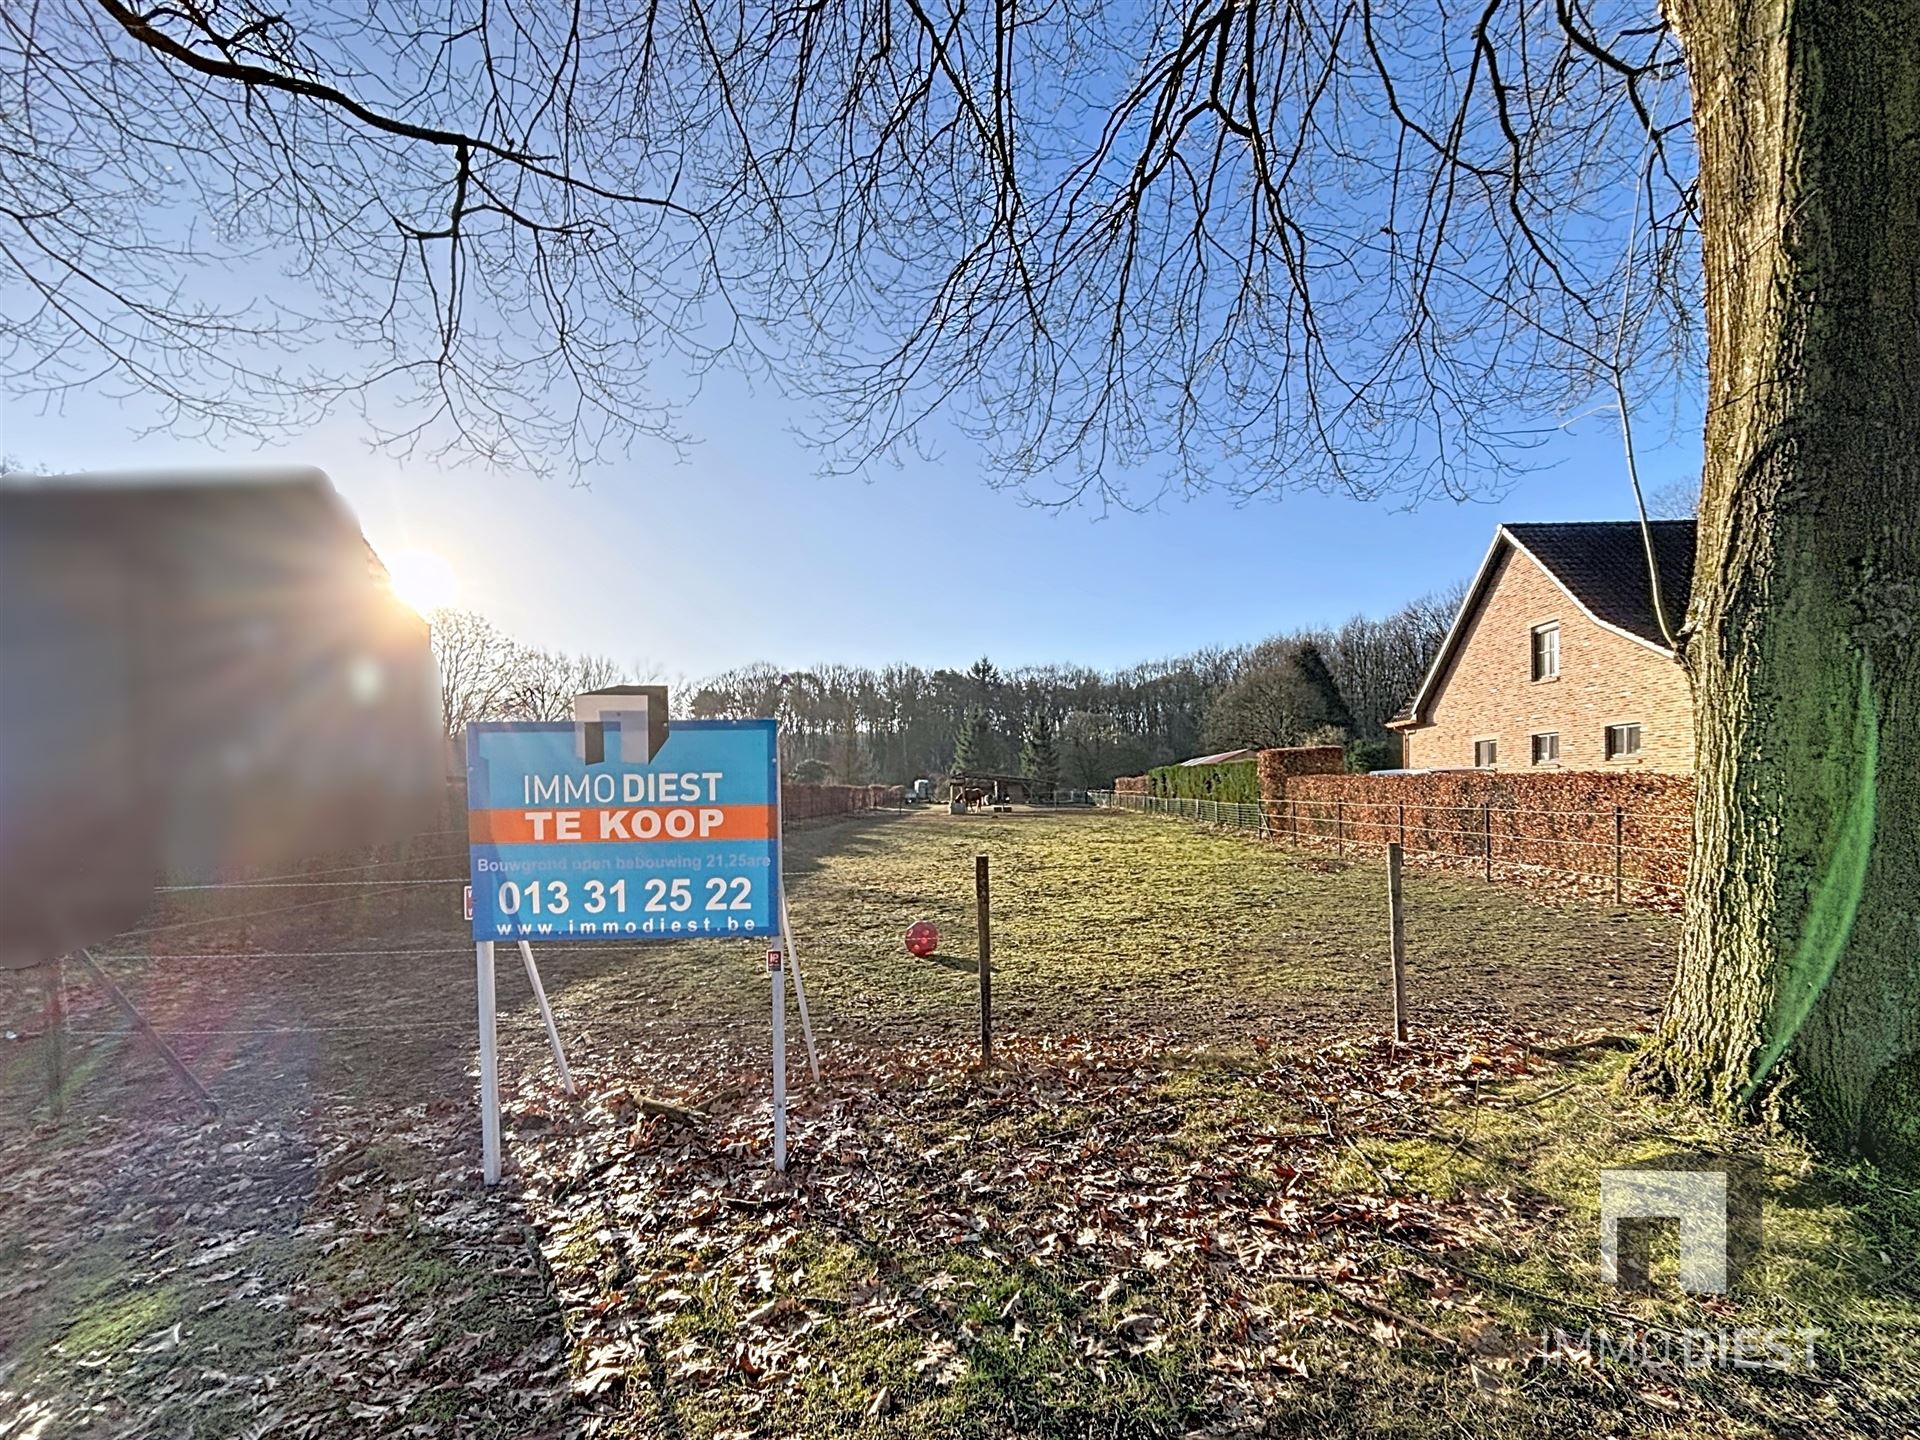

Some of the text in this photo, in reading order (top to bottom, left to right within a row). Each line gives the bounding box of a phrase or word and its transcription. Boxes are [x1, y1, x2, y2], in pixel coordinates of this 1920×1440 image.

[524, 772, 723, 804] IMMO DIEST
[525, 808, 724, 840] TE KOOP
[477, 858, 568, 874] Bouwgrond
[574, 858, 611, 873] open
[616, 855, 702, 871] bebouwing
[499, 877, 752, 915] 013 31 25 22
[497, 916, 756, 936] www.immodiest.be
